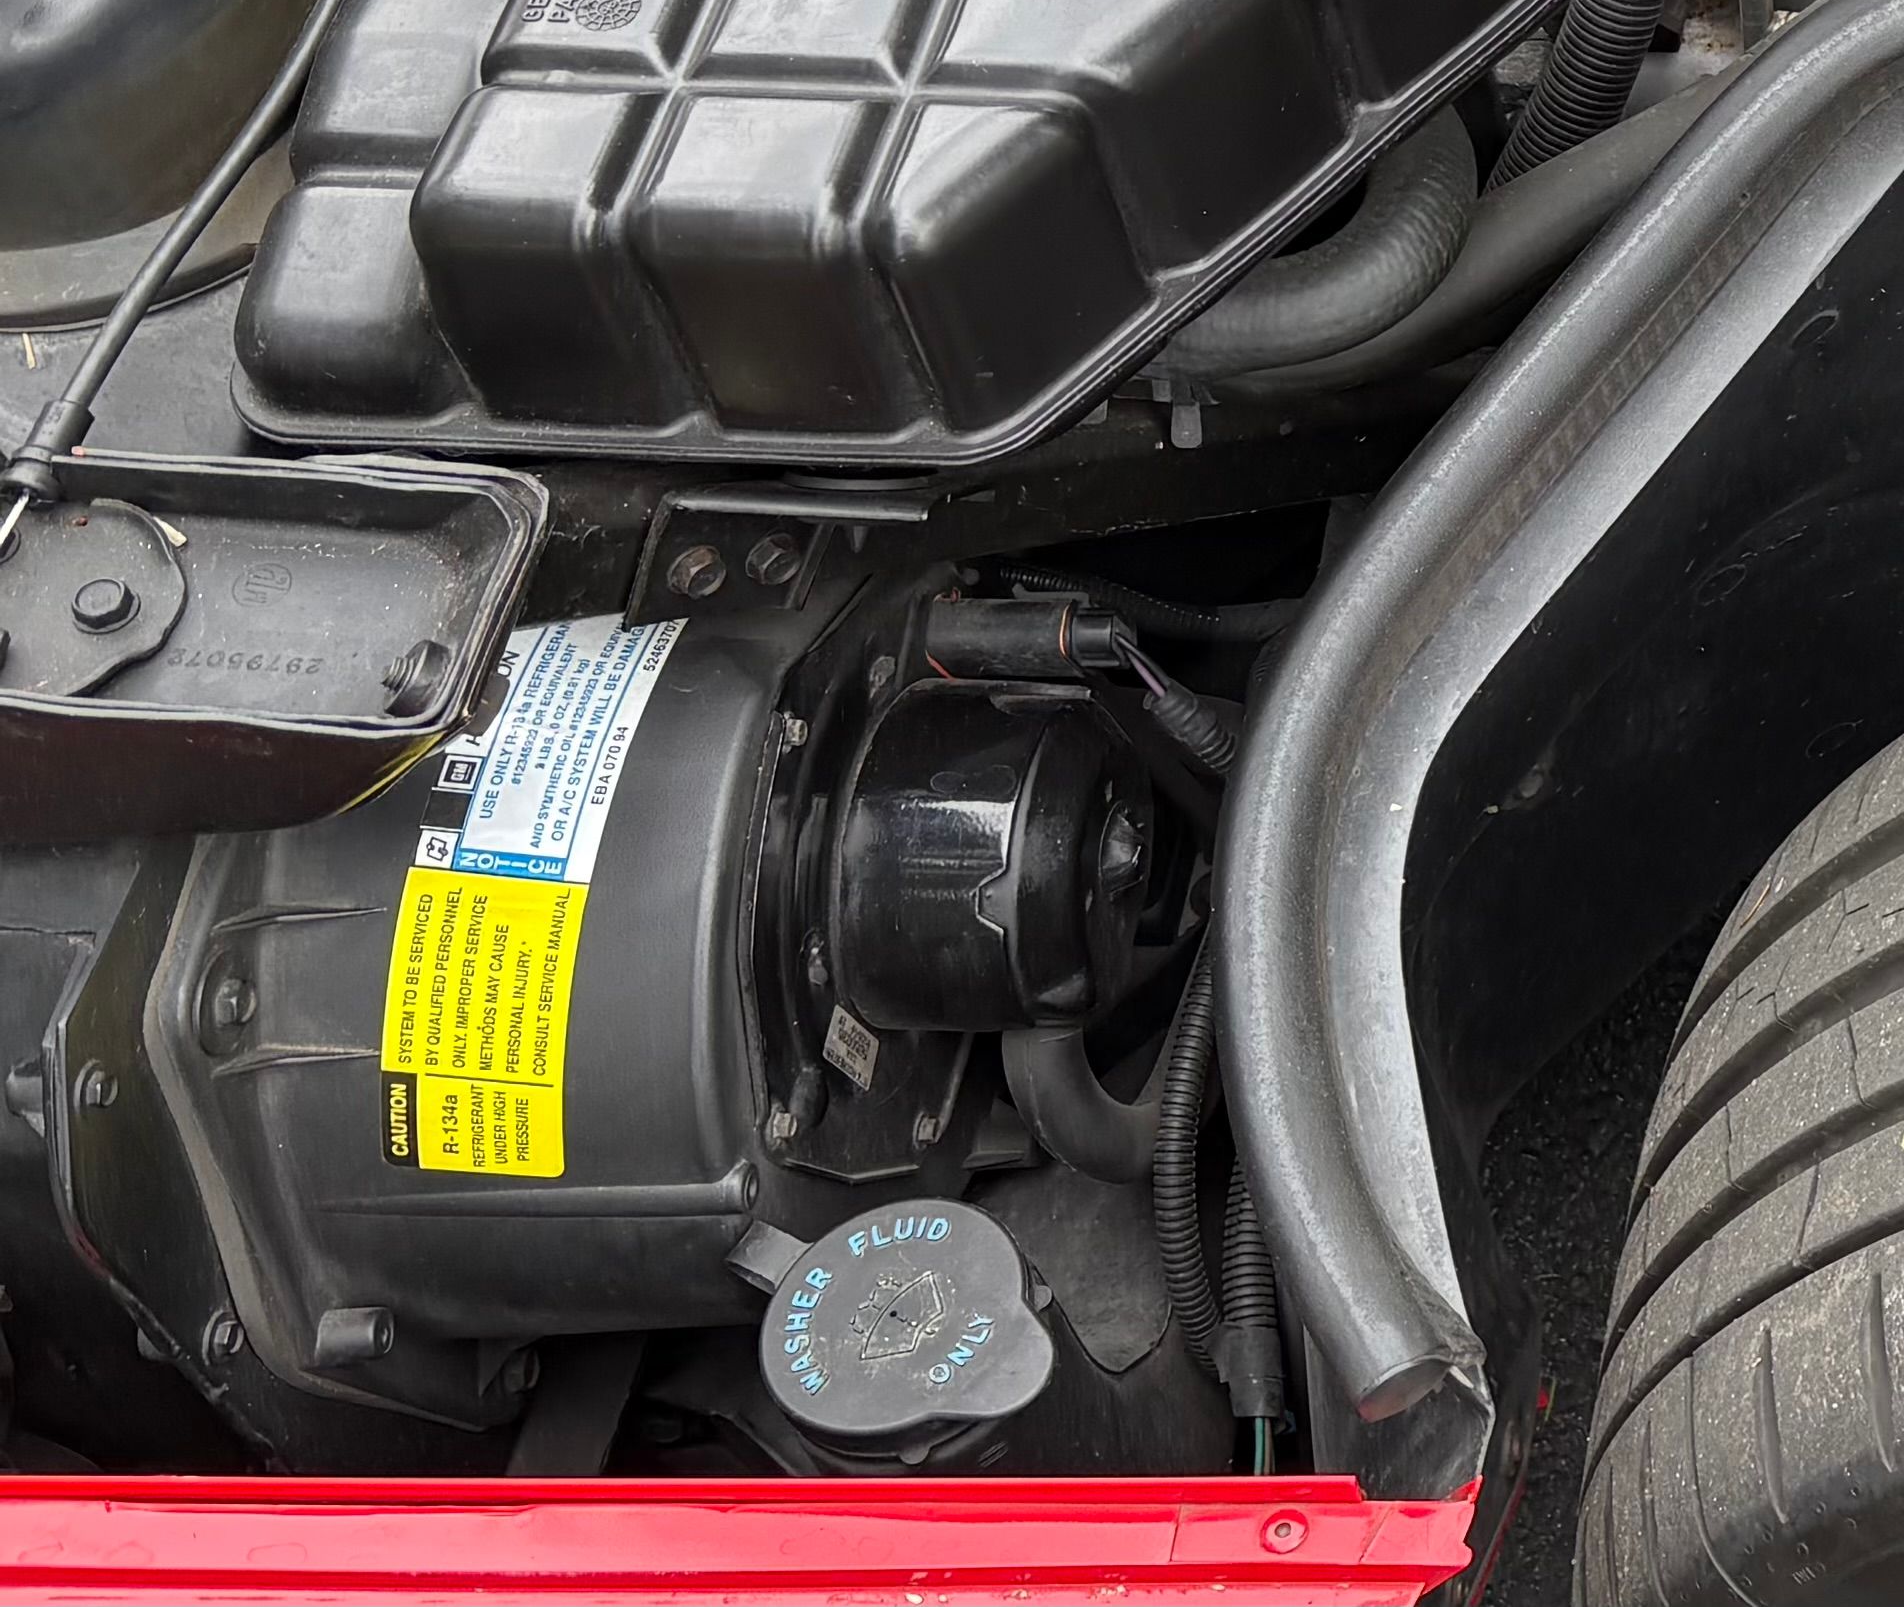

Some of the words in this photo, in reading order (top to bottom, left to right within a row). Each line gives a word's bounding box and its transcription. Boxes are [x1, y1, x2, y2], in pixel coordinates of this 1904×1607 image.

[523, 620, 573, 698] REFRIGERAN
[591, 659, 608, 676] OR
[611, 622, 647, 671] DAMAG
[539, 642, 578, 707] EQUIVALENT
[602, 671, 622, 691] BE
[502, 698, 533, 745] R-134a
[532, 708, 548, 726] OR
[589, 692, 613, 726] WILL
[612, 724, 630, 742] 94
[559, 730, 576, 750] OIL
[568, 727, 598, 786] SYSTEM
[602, 742, 623, 771] 070
[449, 761, 469, 783] GM
[489, 747, 514, 786] ONLY
[537, 752, 569, 820] SYNTHETIC
[590, 772, 612, 806] EBA
[479, 788, 501, 820] USE
[558, 787, 578, 816] A/C
[529, 821, 546, 848] AND
[550, 817, 569, 842] OR
[461, 851, 561, 876] NOTICE
[408, 892, 434, 963] SERVICED
[434, 885, 463, 971] PERSONNEL
[463, 893, 488, 954] SERVICE
[546, 886, 571, 950] MANUAL
[489, 923, 509, 972] CAUSE
[403, 989, 418, 1005] TO
[405, 965, 421, 984] BE
[455, 957, 477, 1029] IMPROPER
[485, 975, 501, 1003] MAY
[512, 946, 533, 999] INJURY.
[538, 953, 559, 1012] SERVICE
[426, 974, 447, 1045] QUALIFIED
[398, 1010, 415, 1064] SYSTEM
[424, 1049, 439, 1065] BY
[451, 1031, 468, 1068] ONLY.
[479, 1005, 498, 1070] METHODS
[505, 1001, 525, 1073] PERSONAL
[532, 1015, 550, 1076] CONSULT
[390, 1082, 409, 1157] CAUTION
[442, 1092, 459, 1155] R-134a
[471, 1082, 486, 1168] REFRIGERANT
[494, 1089, 507, 1121] HIGH
[516, 1096, 529, 1162] PRESSURE
[493, 1123, 508, 1164] UNDER
[784, 1266, 833, 1396] WASHER
[847, 1216, 951, 1258] FLUID
[928, 1314, 995, 1384] ONLY
